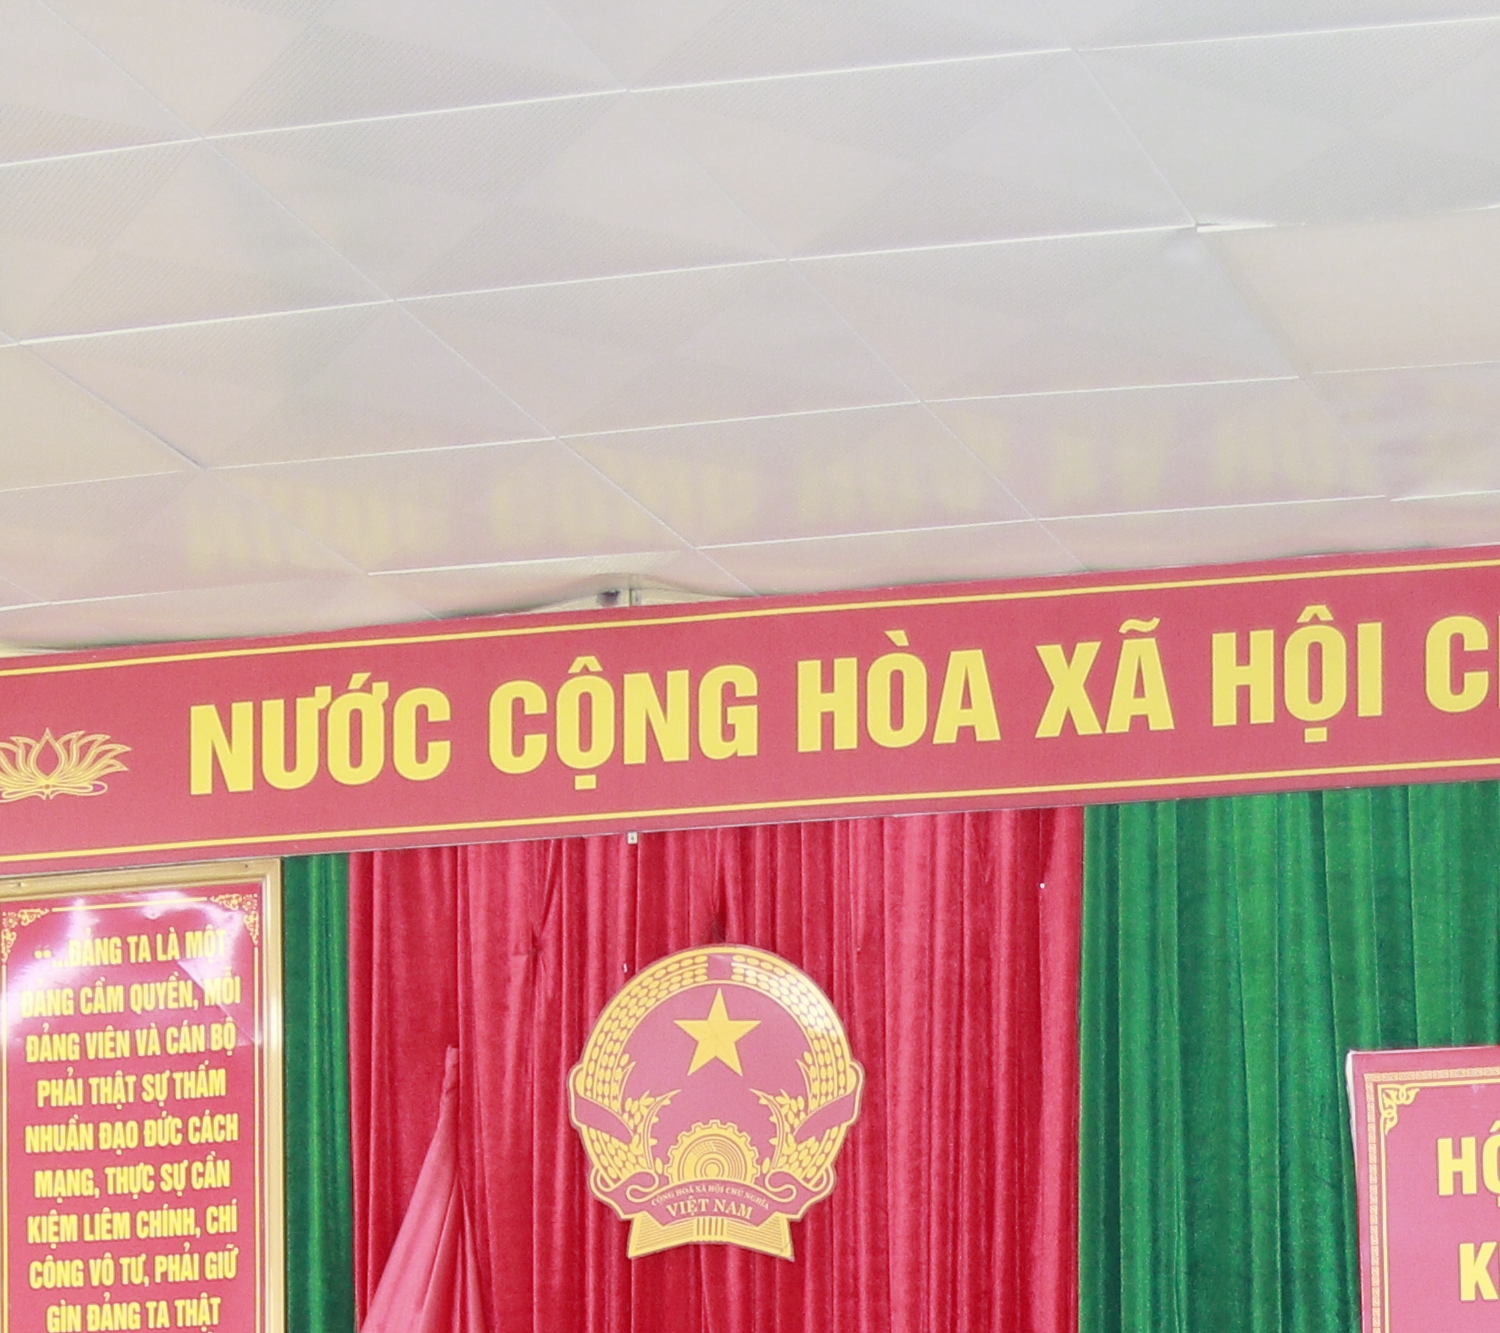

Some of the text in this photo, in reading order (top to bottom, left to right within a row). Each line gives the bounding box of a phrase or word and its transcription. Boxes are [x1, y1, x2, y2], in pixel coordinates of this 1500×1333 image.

[189, 671, 453, 795] NƯỚC
[488, 654, 760, 790] CỘNG
[796, 629, 1002, 753] HÒA
[1036, 618, 1176, 738] XÃ
[1211, 604, 1385, 743] HỘI
[127, 936, 151, 963] TA
[157, 927, 181, 961] LÀ
[186, 924, 226, 961] MỘT
[80, 980, 126, 1014] CẦM
[130, 973, 199, 1013] QUYỀN,
[26, 1017, 237, 1063] ĐẢNG VIÊN VÀ CÁN BỘ
[37, 1062, 228, 1109] PHẢI THẬT SỰ THẤM
[24, 1111, 240, 1154] NHUẦN ĐẠO ĐỨC CÁCH
[34, 1152, 232, 1203] MẠNG, THỰC SỰ CẦN
[27, 1200, 239, 1248] KIỆM LIÊM CHÍNH, CHÍ
[666, 1196, 753, 1219] VIỆT NAM
[29, 1243, 240, 1289] CÔNG VÔ TƯ, PHẢI GIỮ
[46, 1293, 222, 1333] GÌN ĐẢNG TA THẬT
